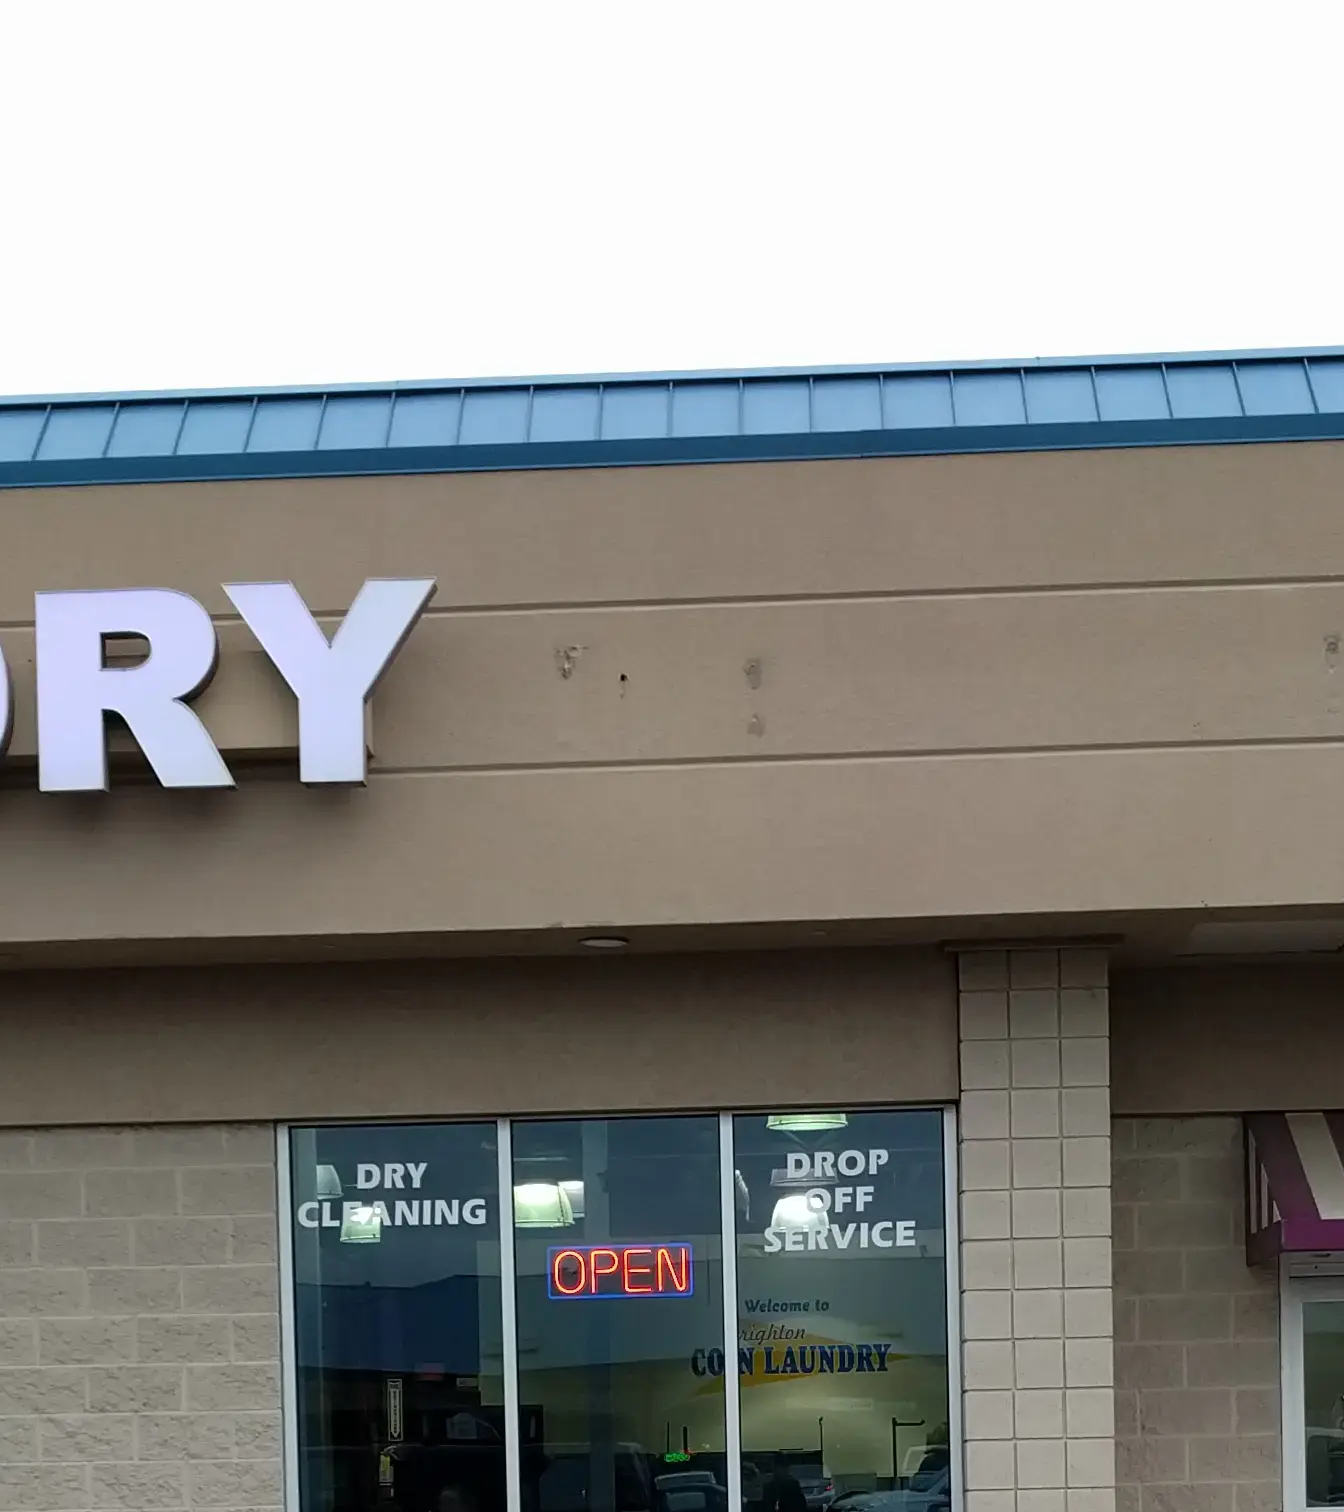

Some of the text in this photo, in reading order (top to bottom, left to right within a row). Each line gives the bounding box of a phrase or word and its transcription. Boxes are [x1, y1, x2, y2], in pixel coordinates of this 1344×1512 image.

[356, 1162, 428, 1190] DRY
[786, 1149, 889, 1179] DROP
[297, 1199, 487, 1228] CLEANING
[806, 1186, 875, 1214] OFF
[763, 1220, 917, 1253] SERVICE
[553, 1247, 689, 1294] OPEN
[745, 1299, 830, 1313] Welcome to
[739, 1323, 805, 1345] righton
[691, 1344, 892, 1378] CON LAUNDRY
